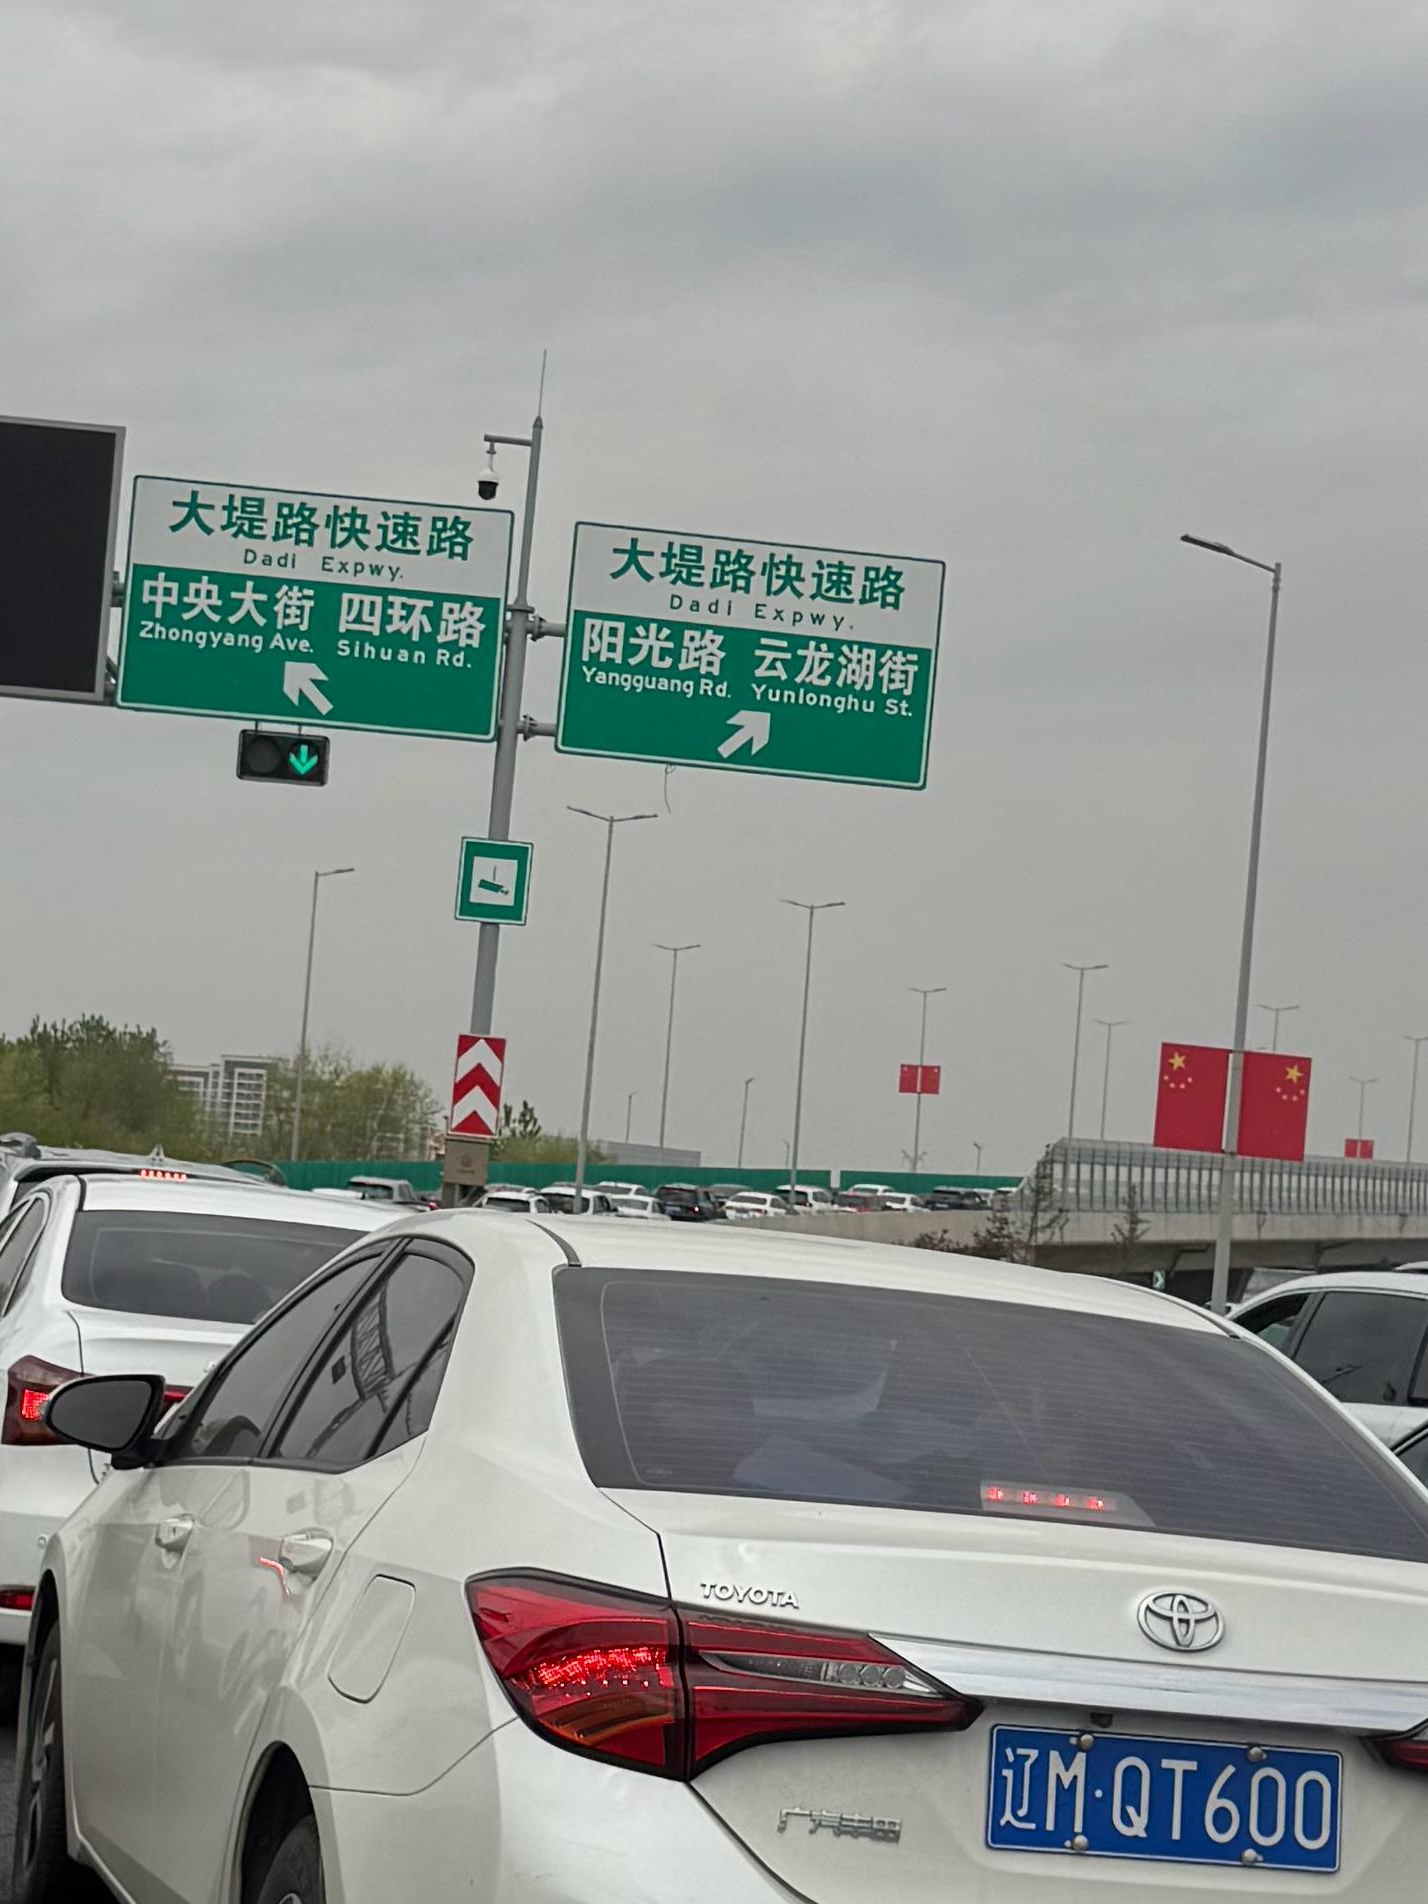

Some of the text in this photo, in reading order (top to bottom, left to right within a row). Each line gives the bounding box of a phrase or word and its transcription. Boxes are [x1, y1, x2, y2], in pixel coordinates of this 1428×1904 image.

[168, 489, 475, 561] 大堤路快速路
[243, 548, 404, 581] Dadi Expwy.
[609, 536, 906, 611] 大堤路快速路
[141, 571, 486, 649] 中央大街 四环路
[669, 594, 854, 631] Dadi Expwy.
[139, 621, 472, 668] Zhongyang Ave. Sihuan Rd.
[581, 617, 919, 696] 阳光路 云龙湖街
[581, 666, 913, 716] Yangguang Rd. Yunlonghu St.
[700, 1582, 800, 1609] TOYOTA
[999, 1746, 1333, 1850] 辽M·QT600
